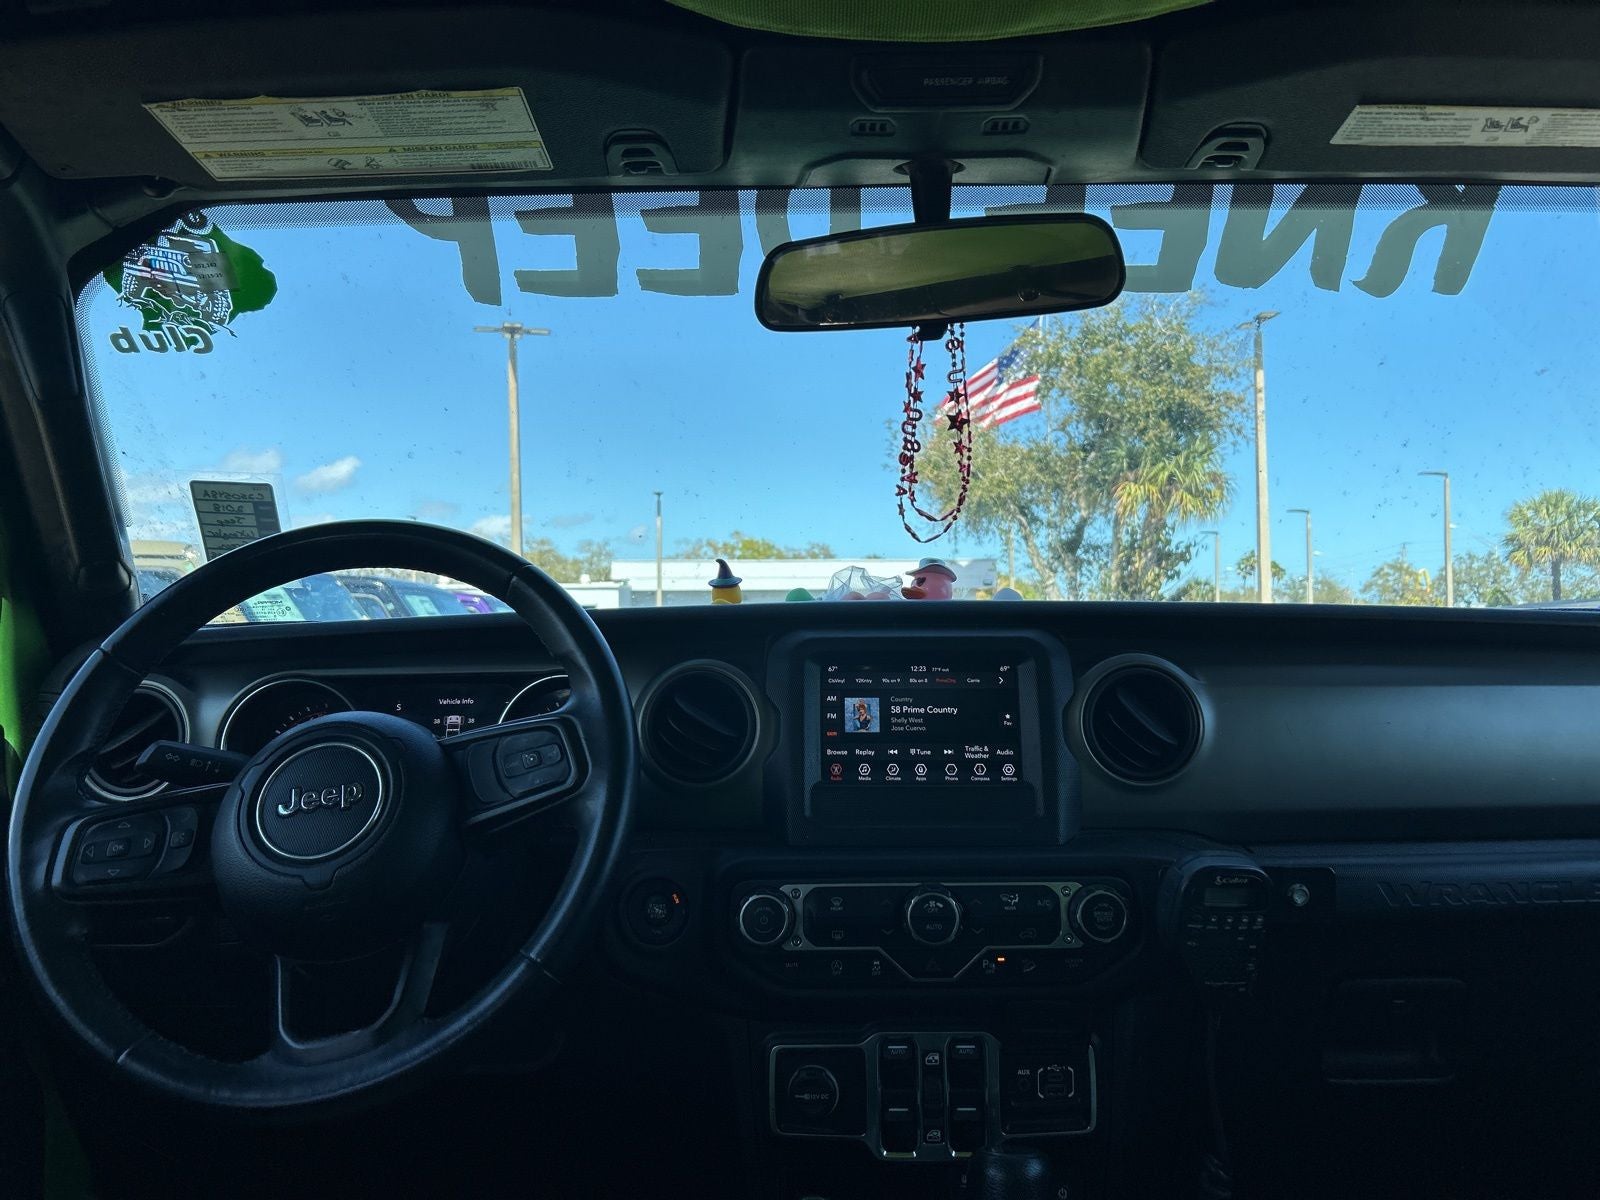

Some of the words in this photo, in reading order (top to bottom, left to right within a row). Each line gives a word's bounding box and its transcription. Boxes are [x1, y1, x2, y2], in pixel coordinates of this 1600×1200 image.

[461, 697, 475, 705] Info
[890, 696, 913, 704] Country
[890, 705, 901, 714] 58
[902, 705, 925, 714] Prime
[926, 705, 958, 716] Country
[890, 716, 908, 725] Shelly
[909, 716, 923, 724] West
[826, 748, 848, 756] Browse
[855, 748, 875, 757] Replay
[996, 748, 1014, 756] Audio
[277, 782, 363, 817] Jeep
[1016, 1068, 1031, 1076] AUX
